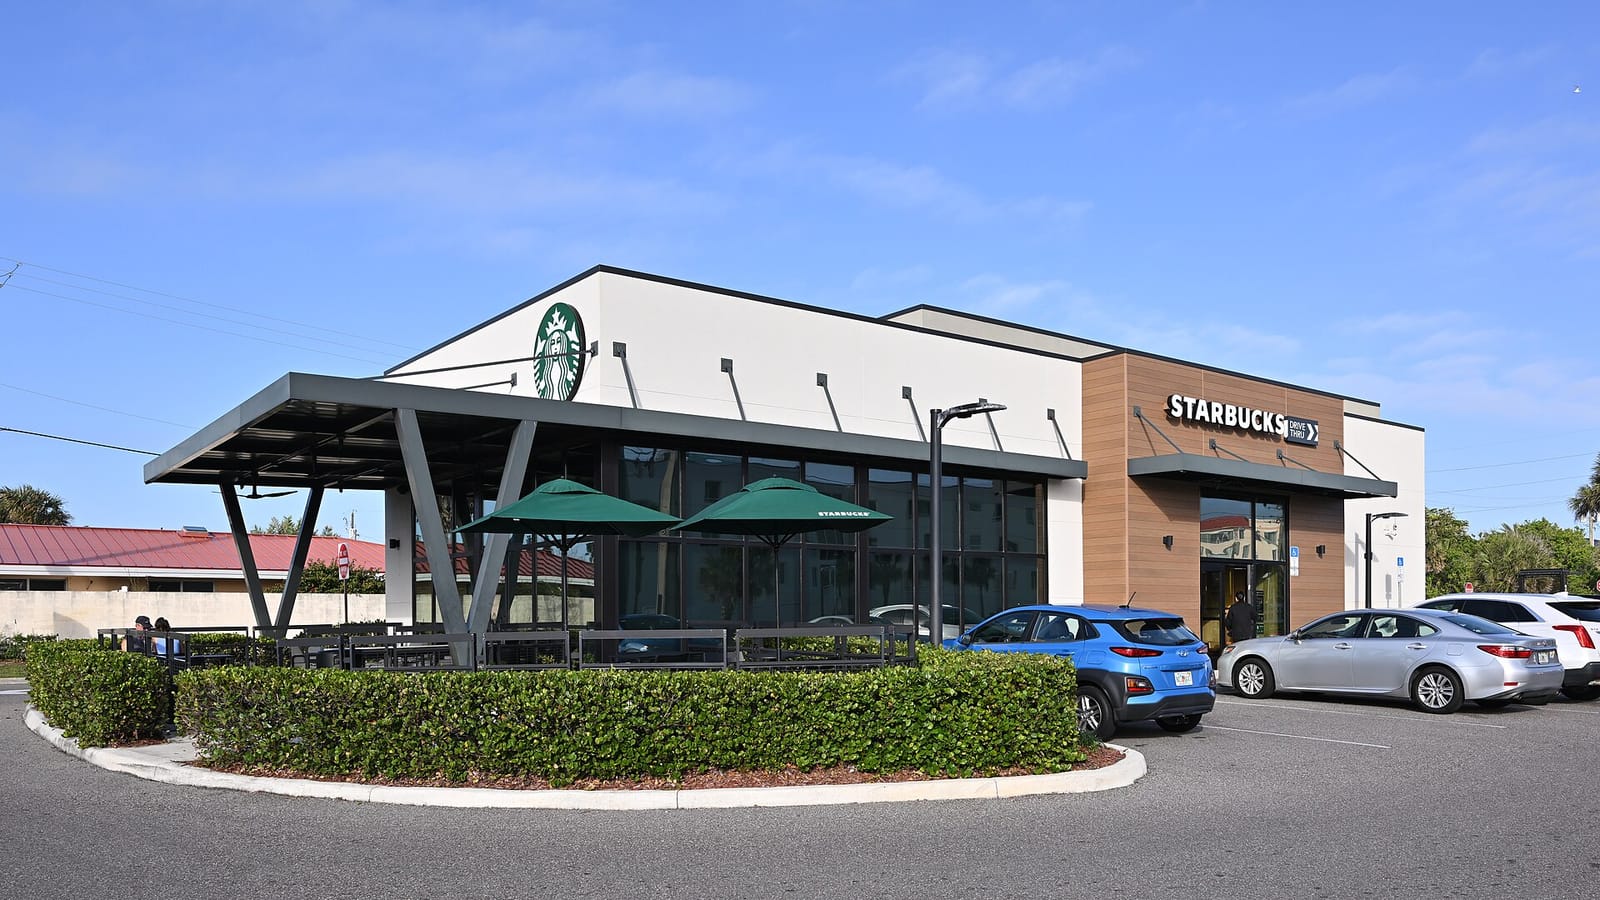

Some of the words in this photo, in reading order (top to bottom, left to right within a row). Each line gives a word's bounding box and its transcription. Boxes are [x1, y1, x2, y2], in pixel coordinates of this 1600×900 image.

[1171, 394, 1285, 435] STARBUCKS
[1289, 420, 1306, 431] DRIVE
[1290, 428, 1305, 439] THRU
